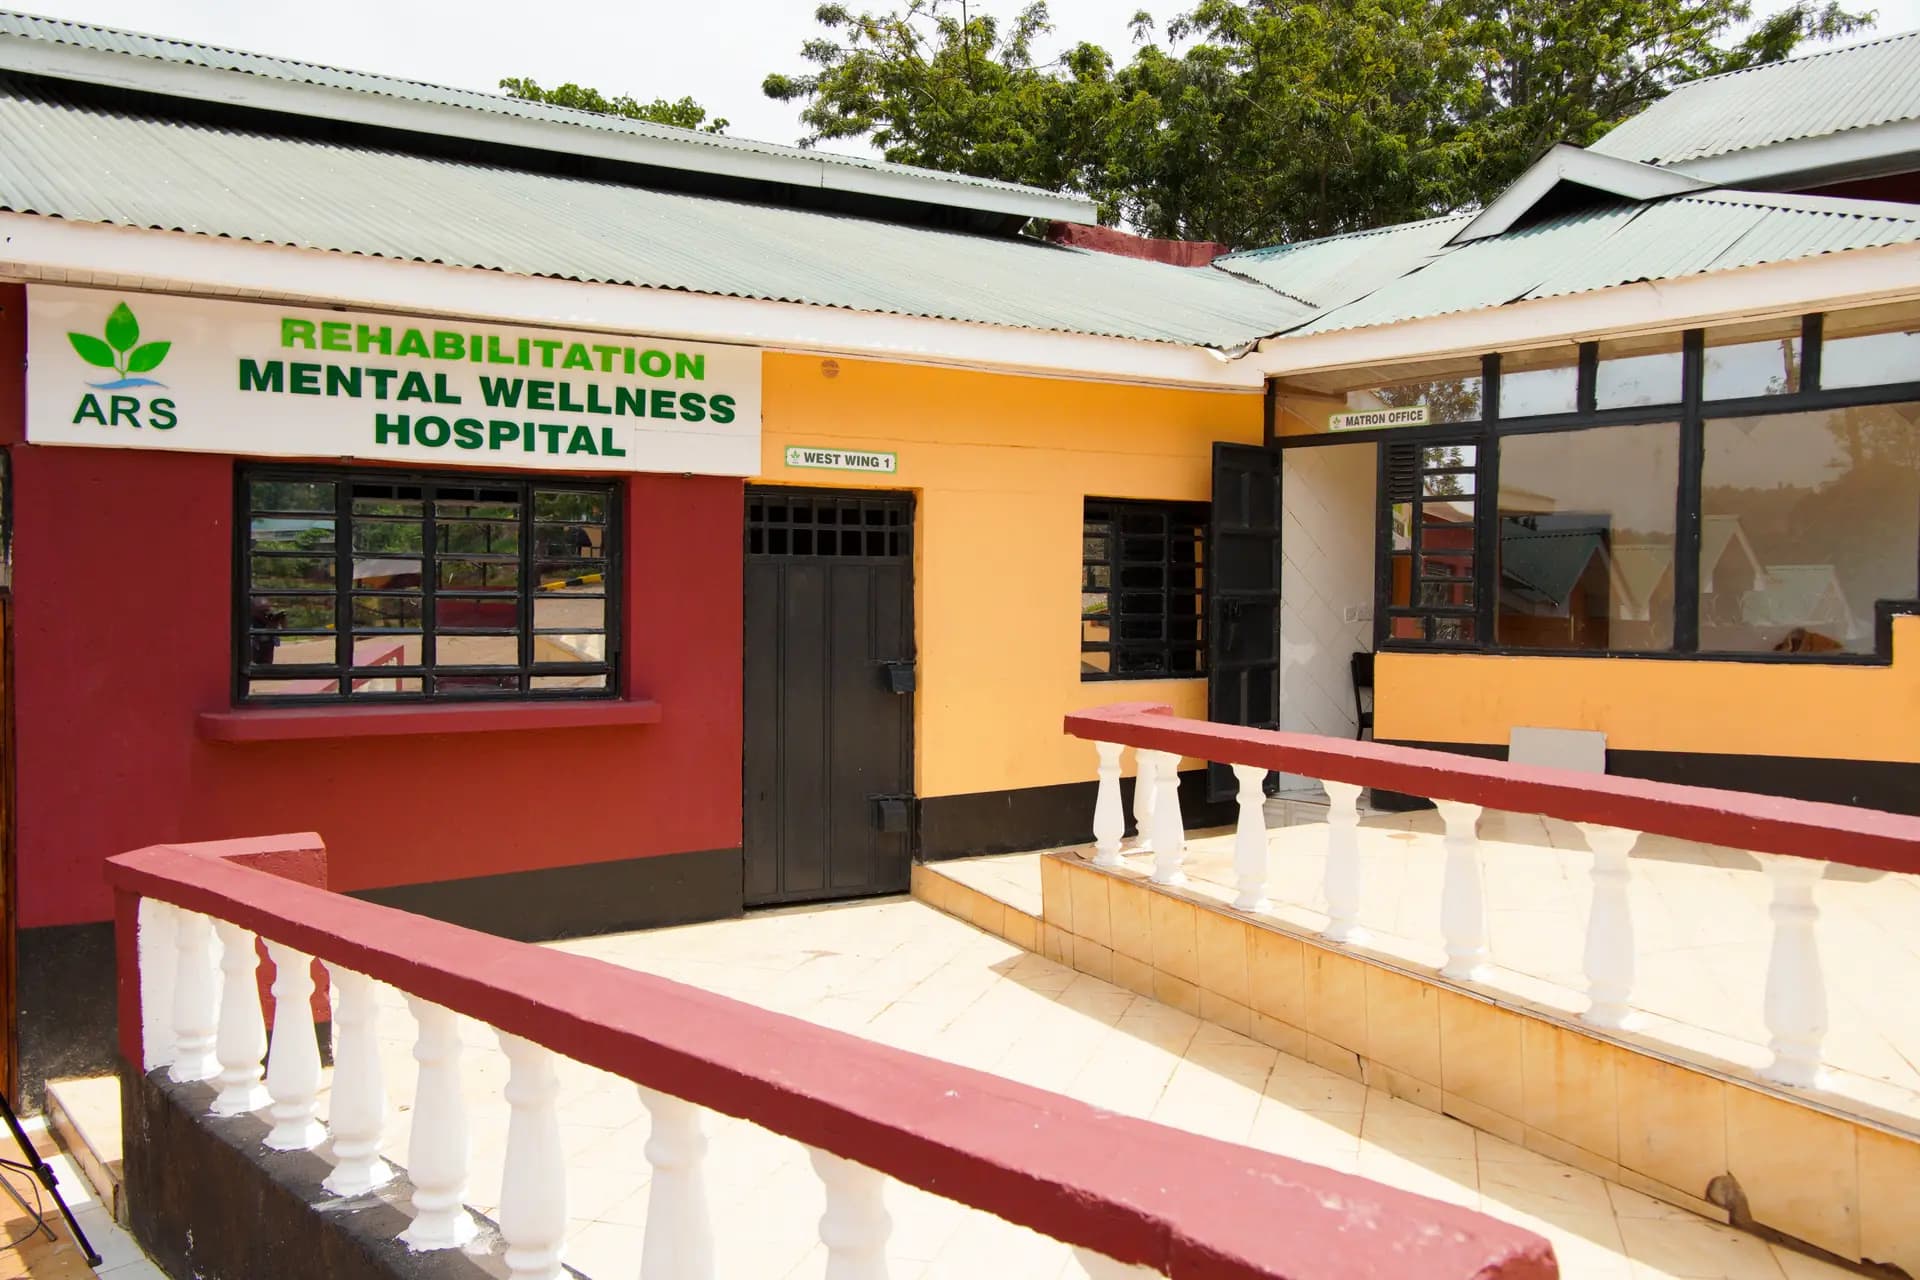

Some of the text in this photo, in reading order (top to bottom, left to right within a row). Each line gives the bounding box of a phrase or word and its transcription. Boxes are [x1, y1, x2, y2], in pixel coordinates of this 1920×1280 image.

[280, 317, 706, 380] REHABILITATION
[72, 392, 178, 430] ARS
[239, 359, 737, 424] MENTAL WELLNESS
[375, 413, 627, 457] HOSPITAL
[1345, 410, 1423, 426] MATRON OFFICE
[804, 452, 890, 468] WEST WING 1
